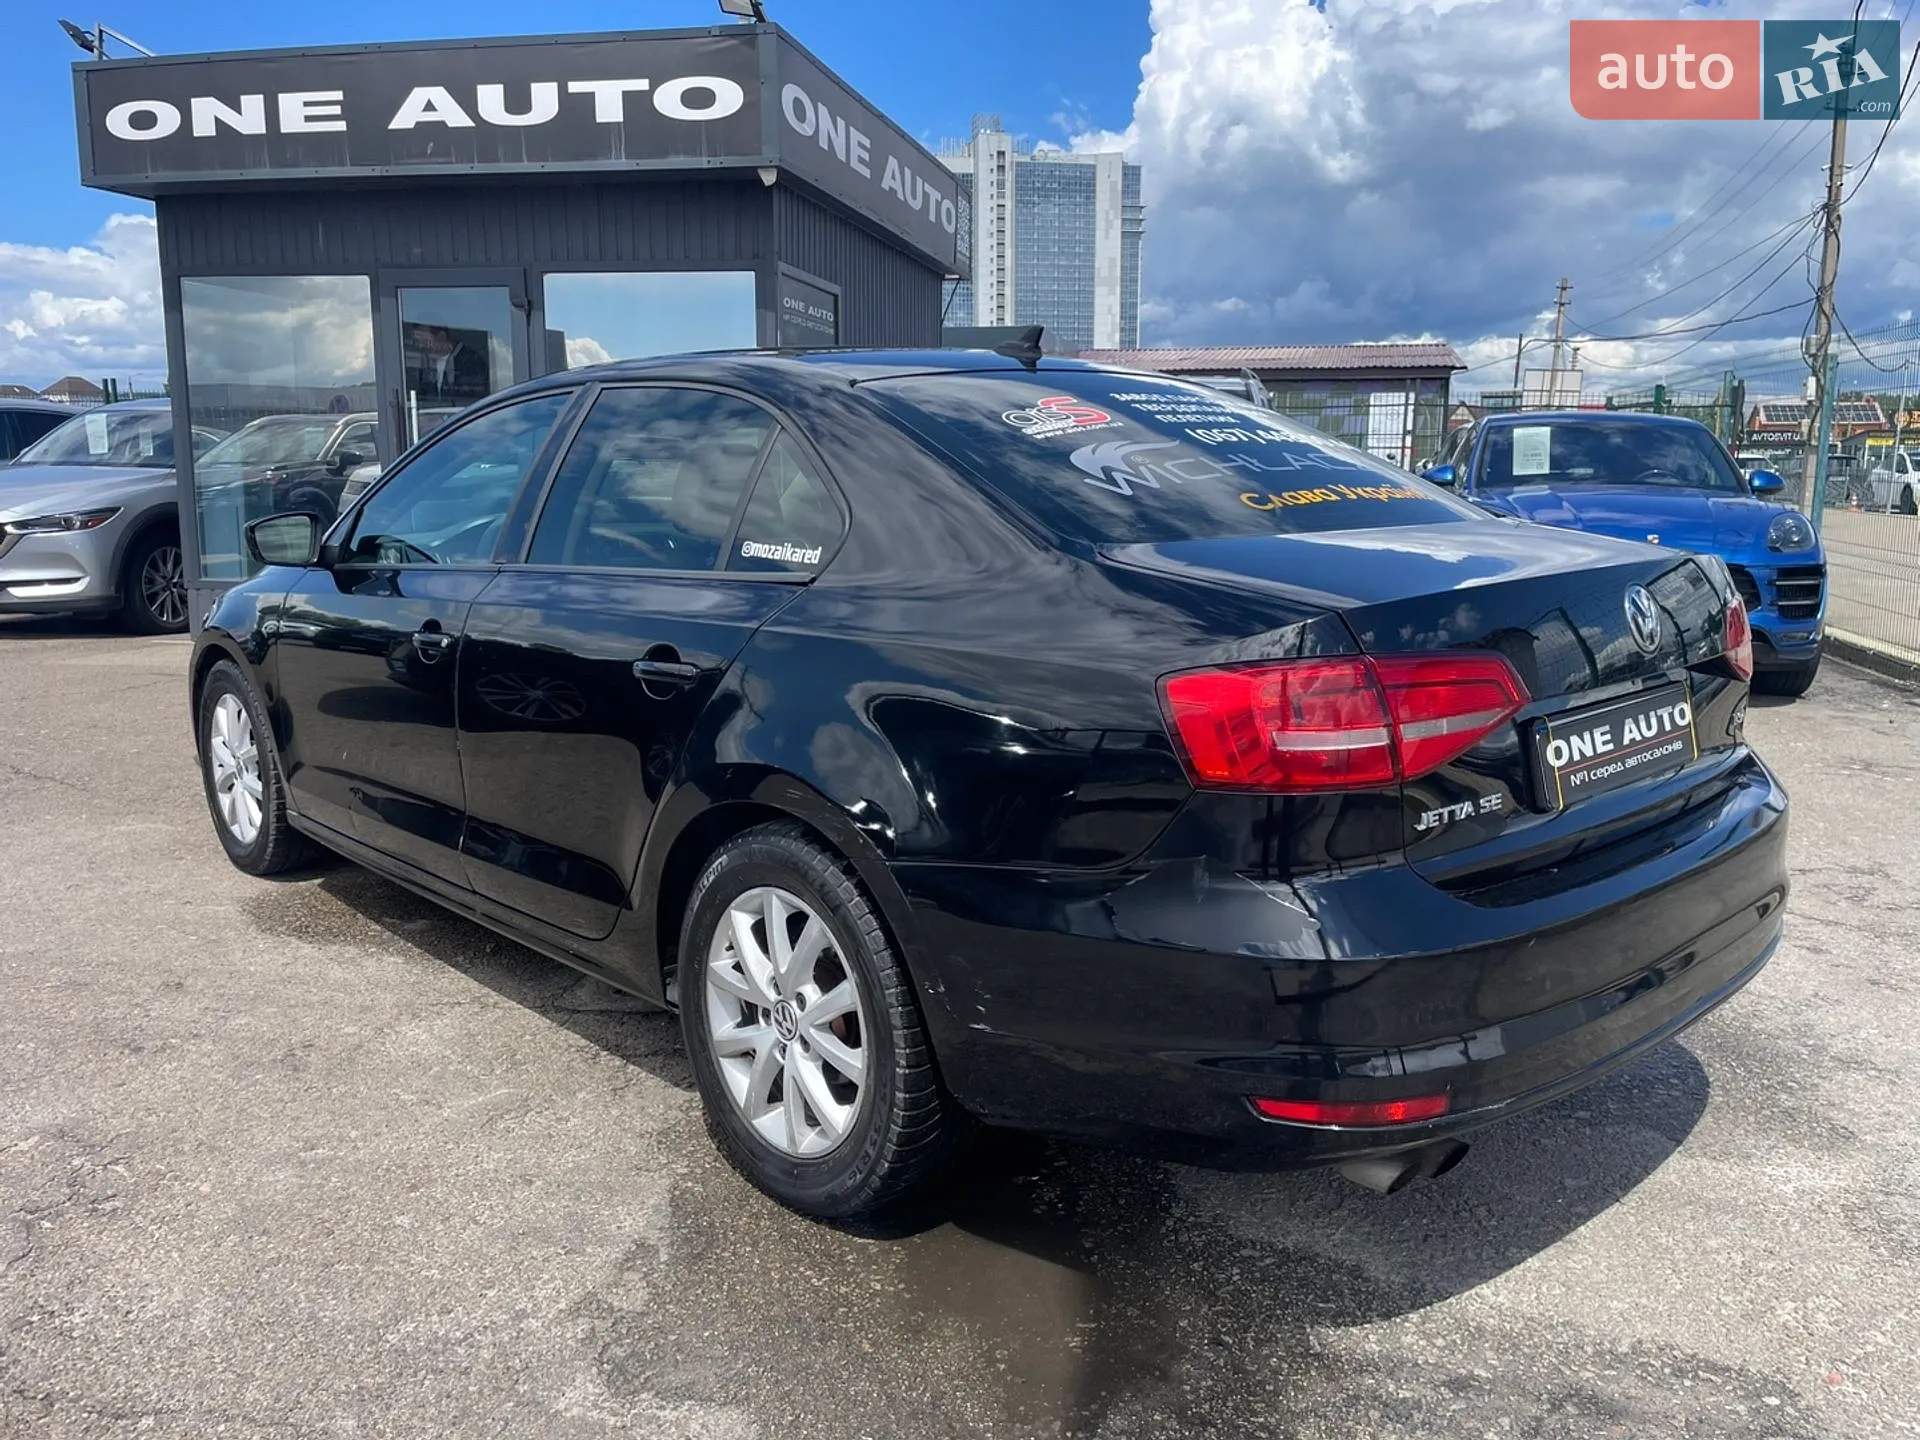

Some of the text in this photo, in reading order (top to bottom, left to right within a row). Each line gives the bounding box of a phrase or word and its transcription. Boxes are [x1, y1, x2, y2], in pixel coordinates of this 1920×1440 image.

[105, 76, 745, 141] ONE AUTO
[781, 83, 956, 234] ONE AUTO
[783, 297, 834, 322] ONE AUTO
[1239, 485, 1341, 512] Слава
[741, 540, 823, 564] @mozaikared
[1546, 701, 1692, 768] ONE AUTO
[1590, 761, 1625, 780] серед
[1625, 739, 1684, 767] автосалонів
[1413, 793, 1503, 831] JETTA SE
